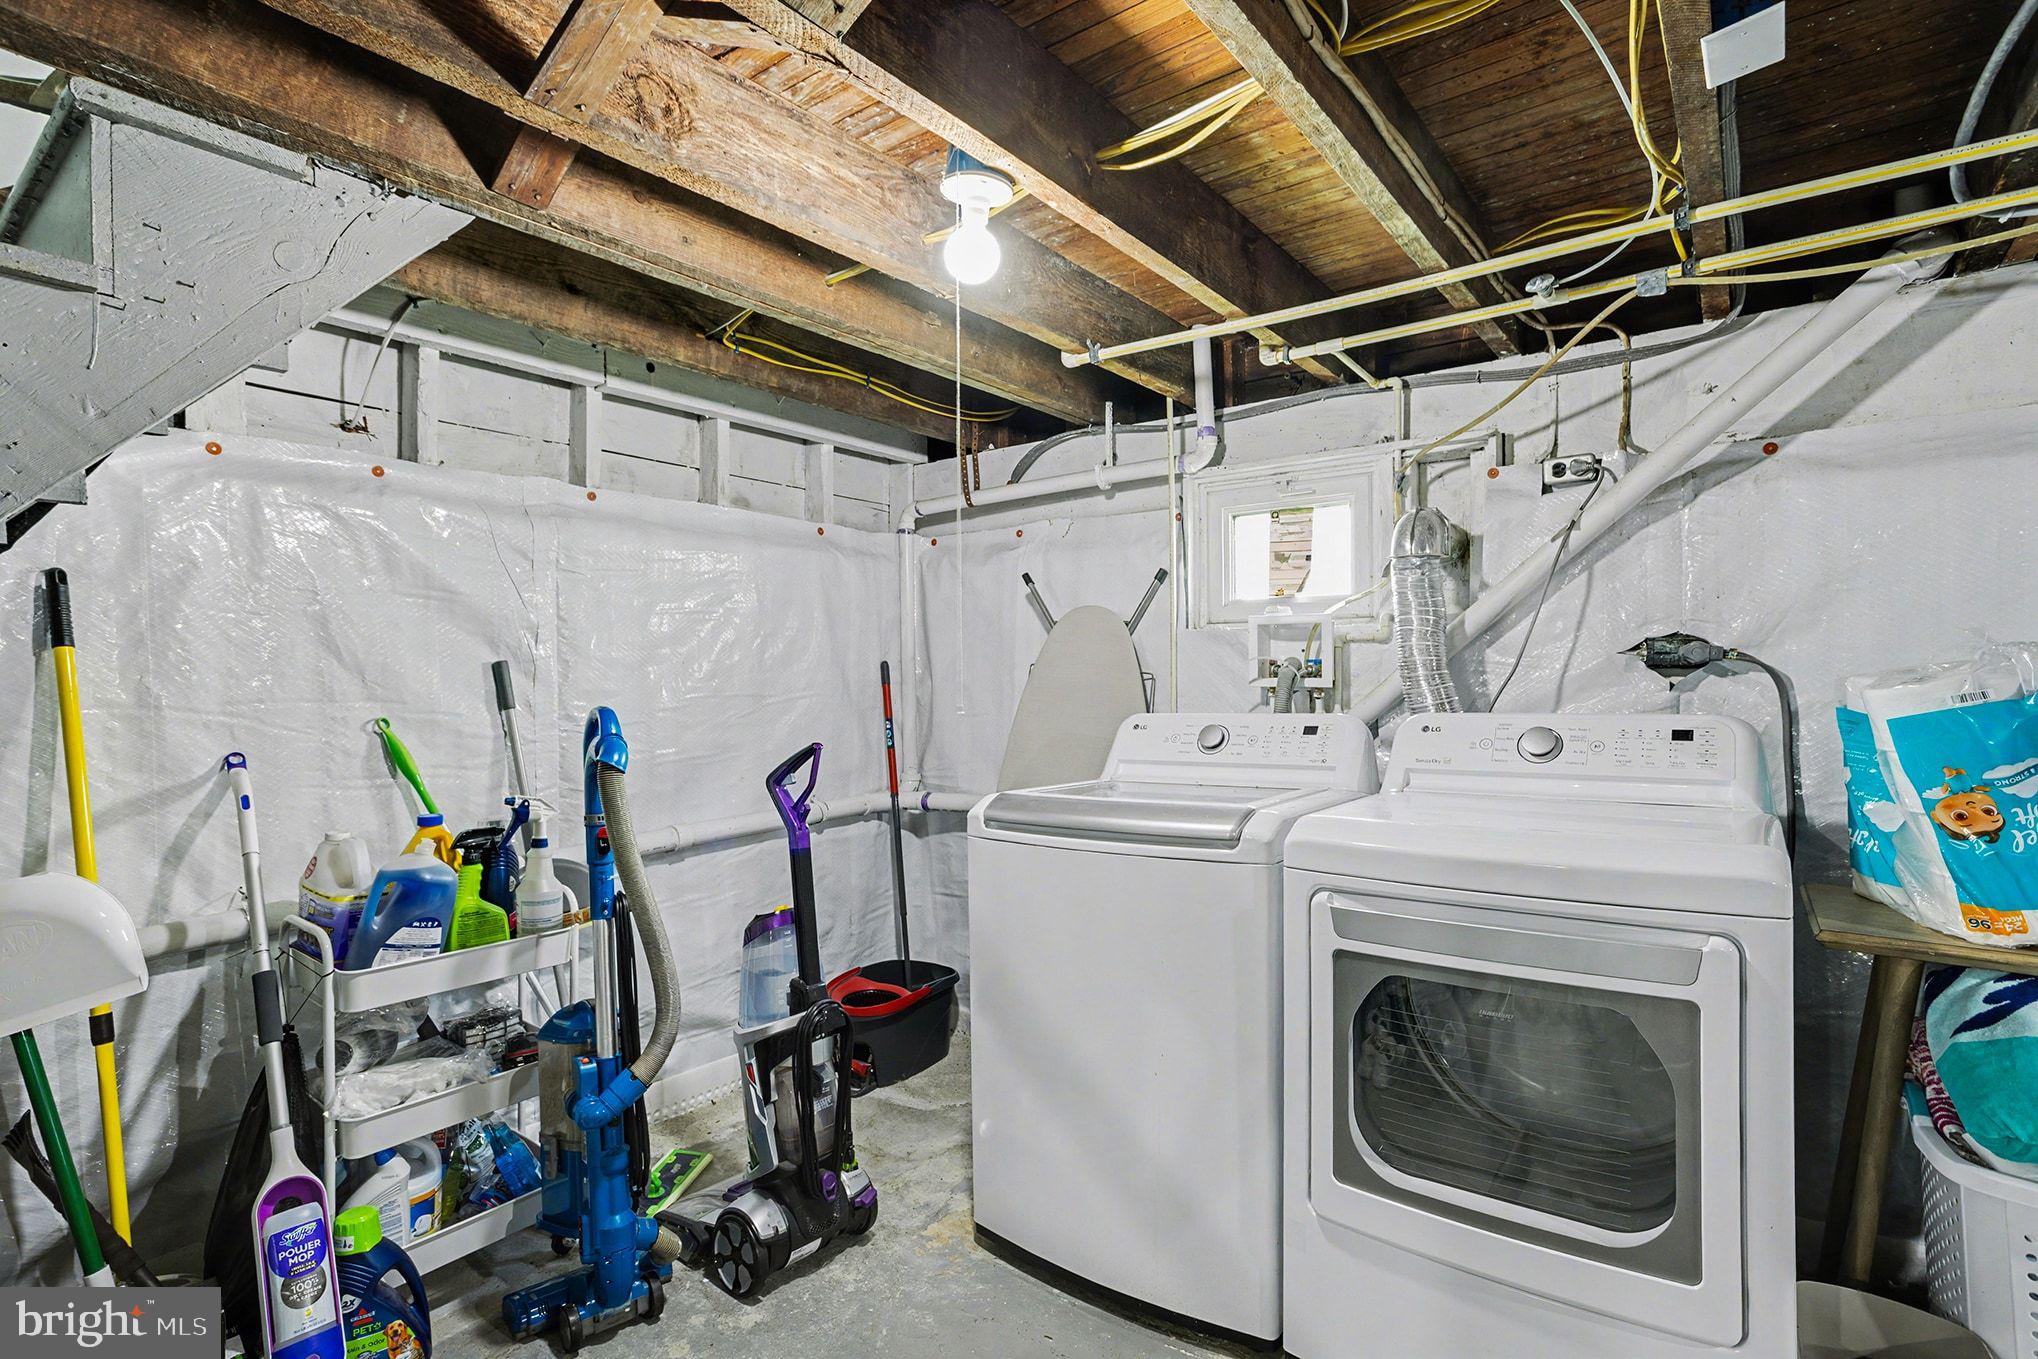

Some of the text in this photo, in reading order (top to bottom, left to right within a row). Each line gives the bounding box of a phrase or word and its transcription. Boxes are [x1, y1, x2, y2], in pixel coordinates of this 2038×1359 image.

[1994, 771, 2029, 787] STRONG
[1968, 918, 1992, 930] 96
[279, 1222, 318, 1247] Swiffer
[278, 1238, 321, 1261] POWER
[288, 1250, 315, 1267] MOP
[353, 1324, 374, 1337] PET
[367, 1339, 386, 1347] Odor
